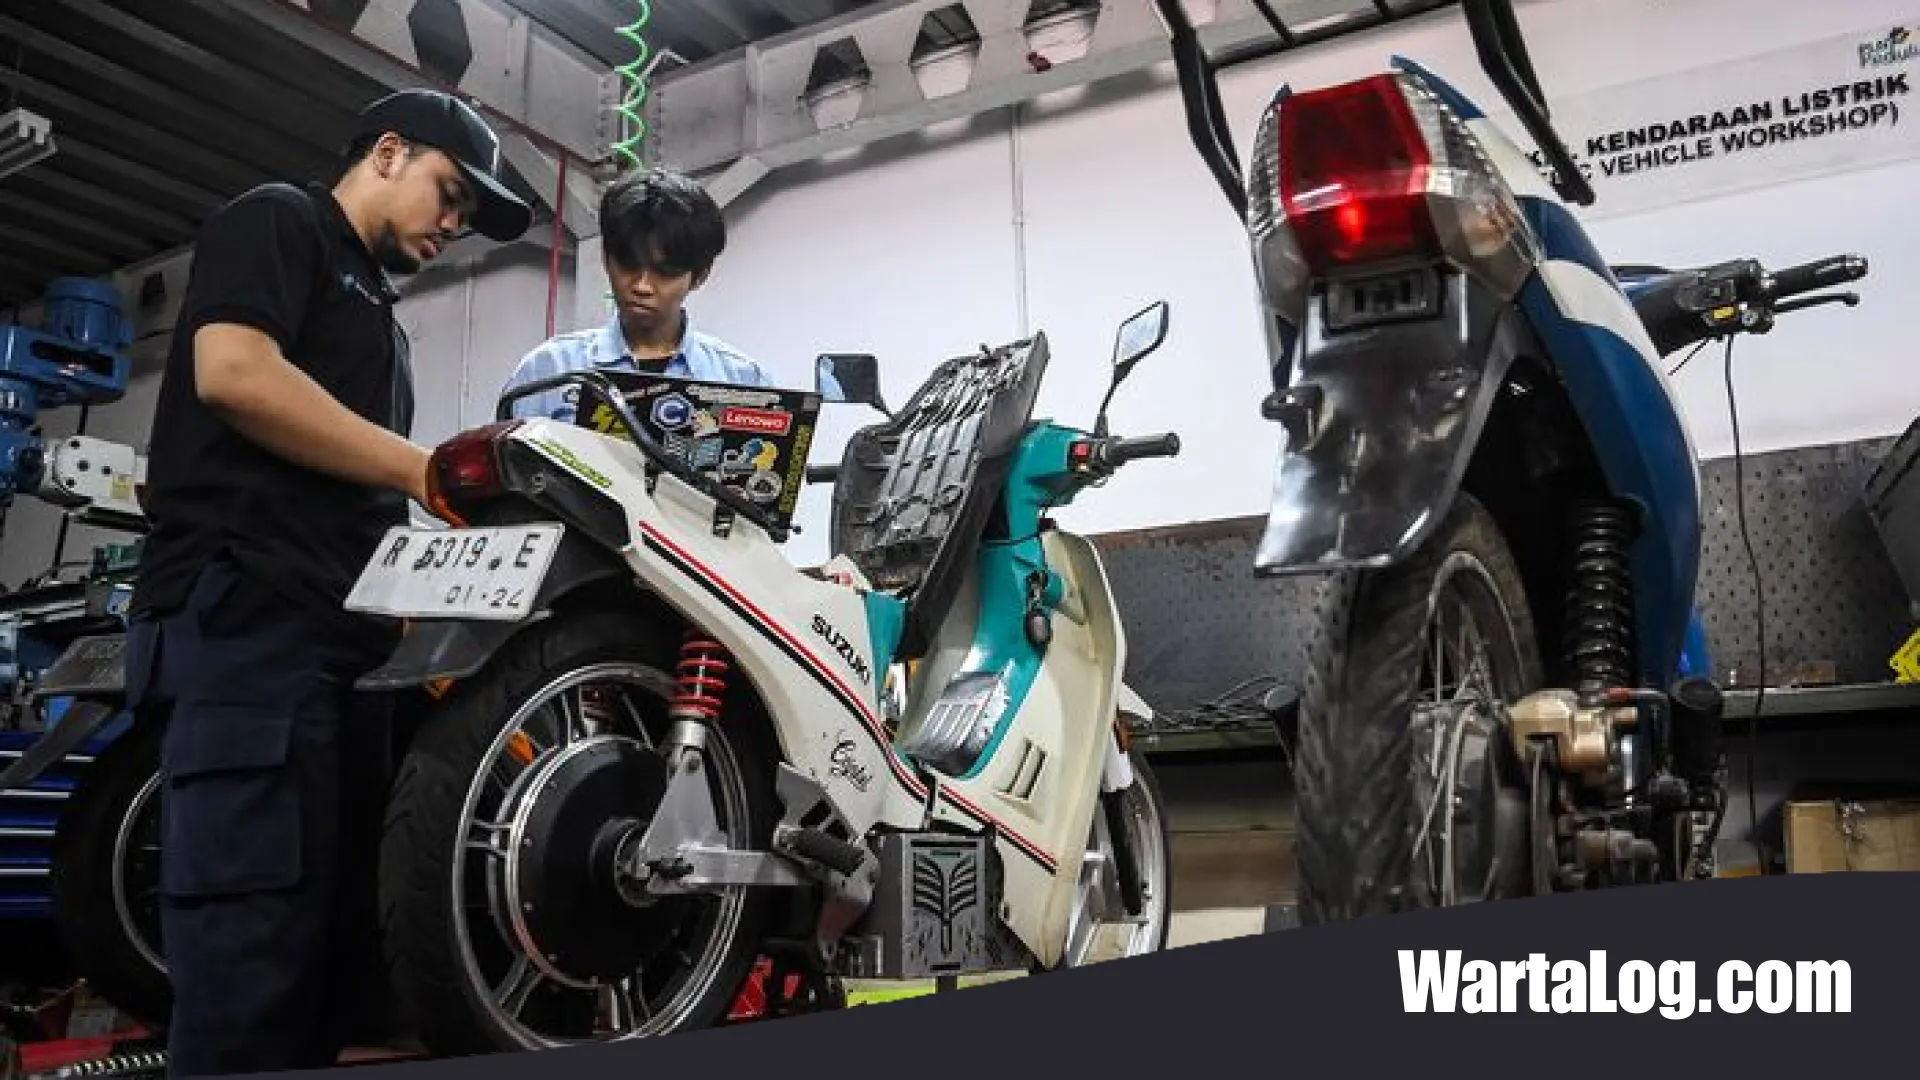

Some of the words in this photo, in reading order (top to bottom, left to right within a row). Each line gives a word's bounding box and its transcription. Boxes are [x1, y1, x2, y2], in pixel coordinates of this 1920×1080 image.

[1586, 101, 1773, 157] KENDARAAN
[1782, 73, 1910, 117] LISTRIK
[1600, 138, 1714, 178] VEHICLE
[1722, 101, 1900, 155] WORKSHOP)
[726, 408, 786, 429] Lenovo
[383, 534, 410, 568] R
[416, 536, 489, 570] 6319
[513, 533, 541, 568] E
[811, 613, 870, 686] SUZUKI
